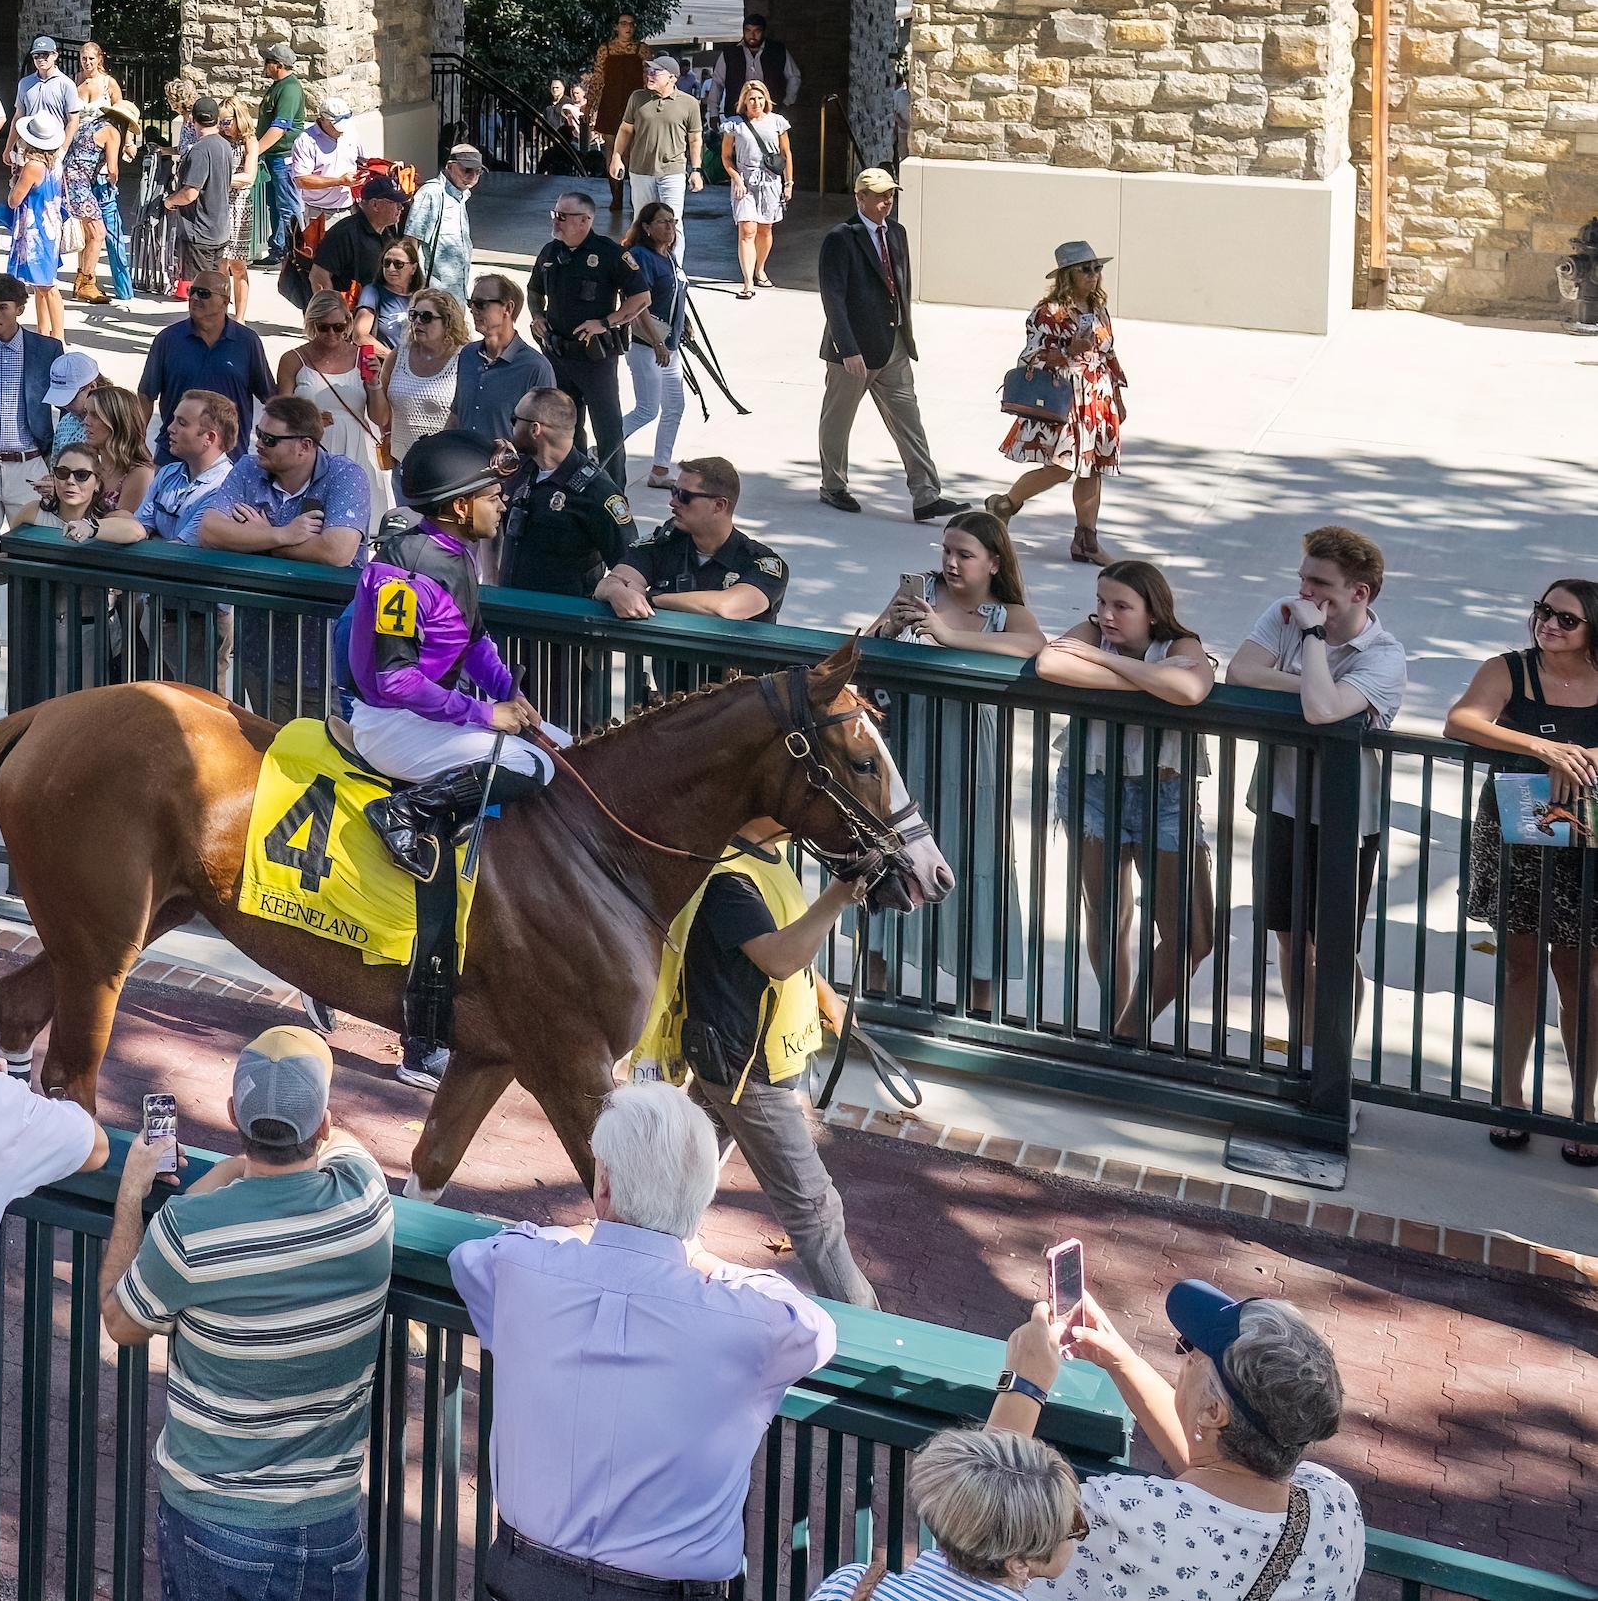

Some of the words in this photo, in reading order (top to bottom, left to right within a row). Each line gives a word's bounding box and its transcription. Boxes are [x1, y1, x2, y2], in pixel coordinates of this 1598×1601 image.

[383, 589, 407, 632] 4
[263, 773, 337, 894] 4
[259, 893, 369, 945] KEENELAND
